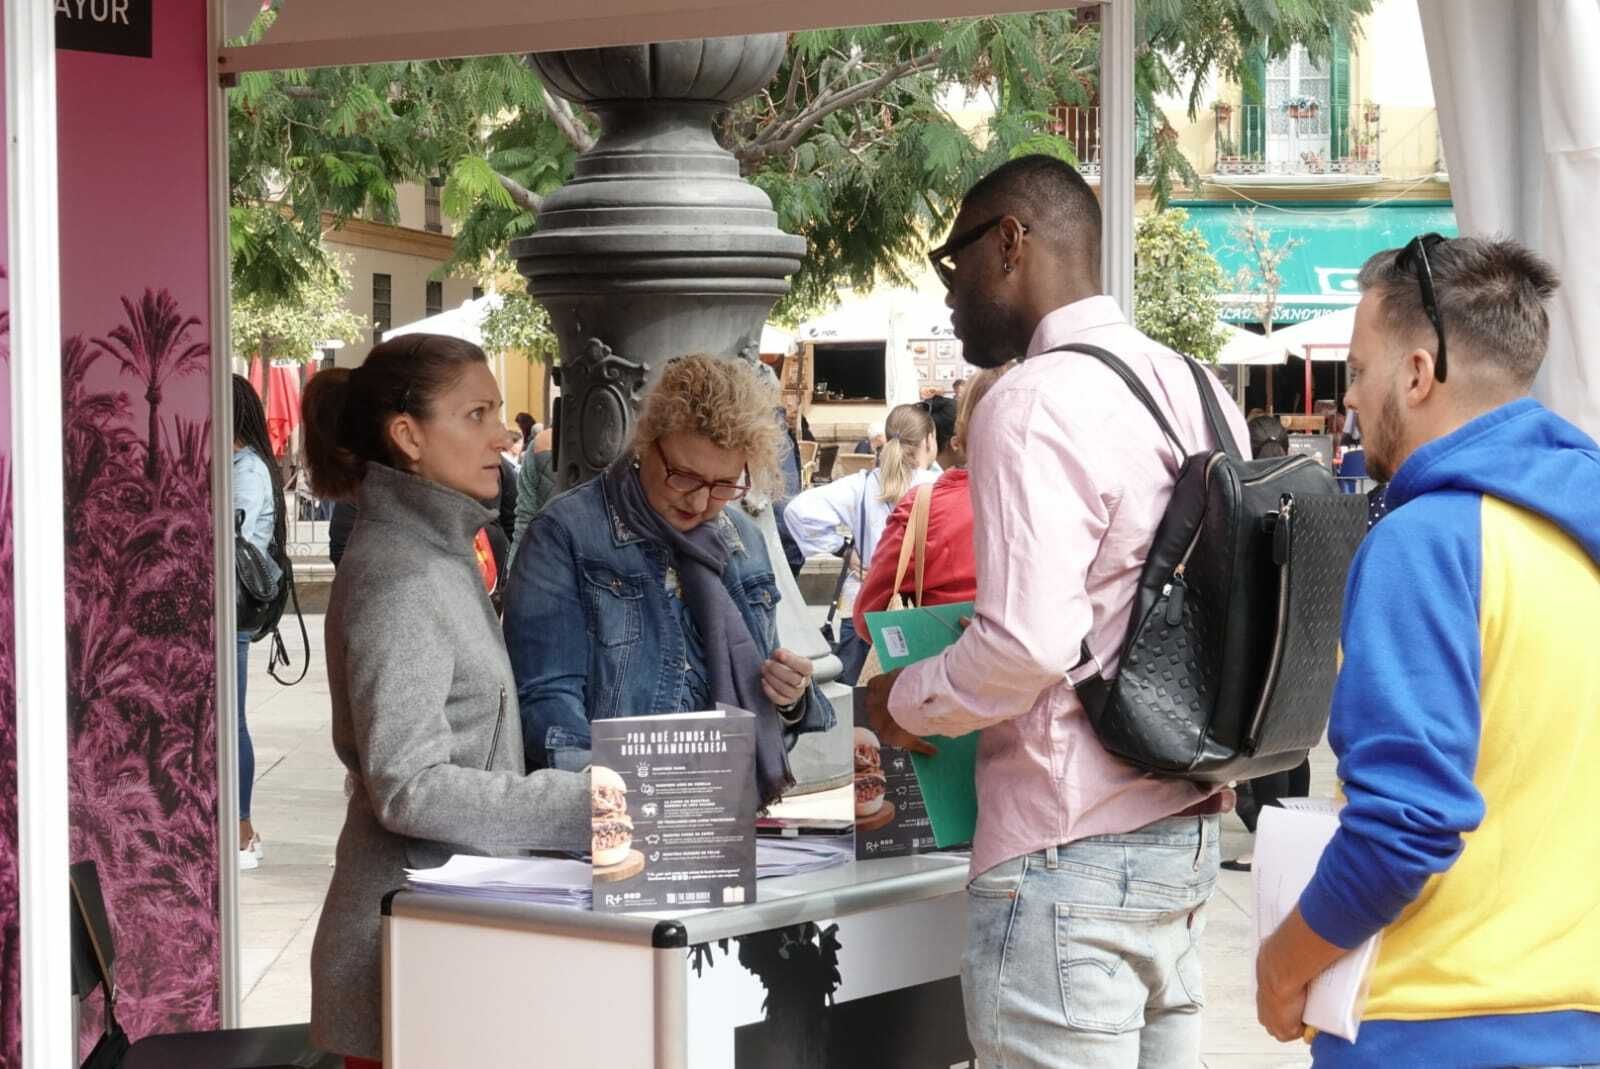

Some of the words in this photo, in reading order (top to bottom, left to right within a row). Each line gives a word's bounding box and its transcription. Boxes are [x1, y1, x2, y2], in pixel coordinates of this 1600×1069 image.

[55, 0, 129, 25] AYOR
[626, 732, 646, 744] POR
[710, 729, 721, 742] LA
[657, 741, 728, 755] HAMBURGUESA
[605, 893, 623, 905] R+
